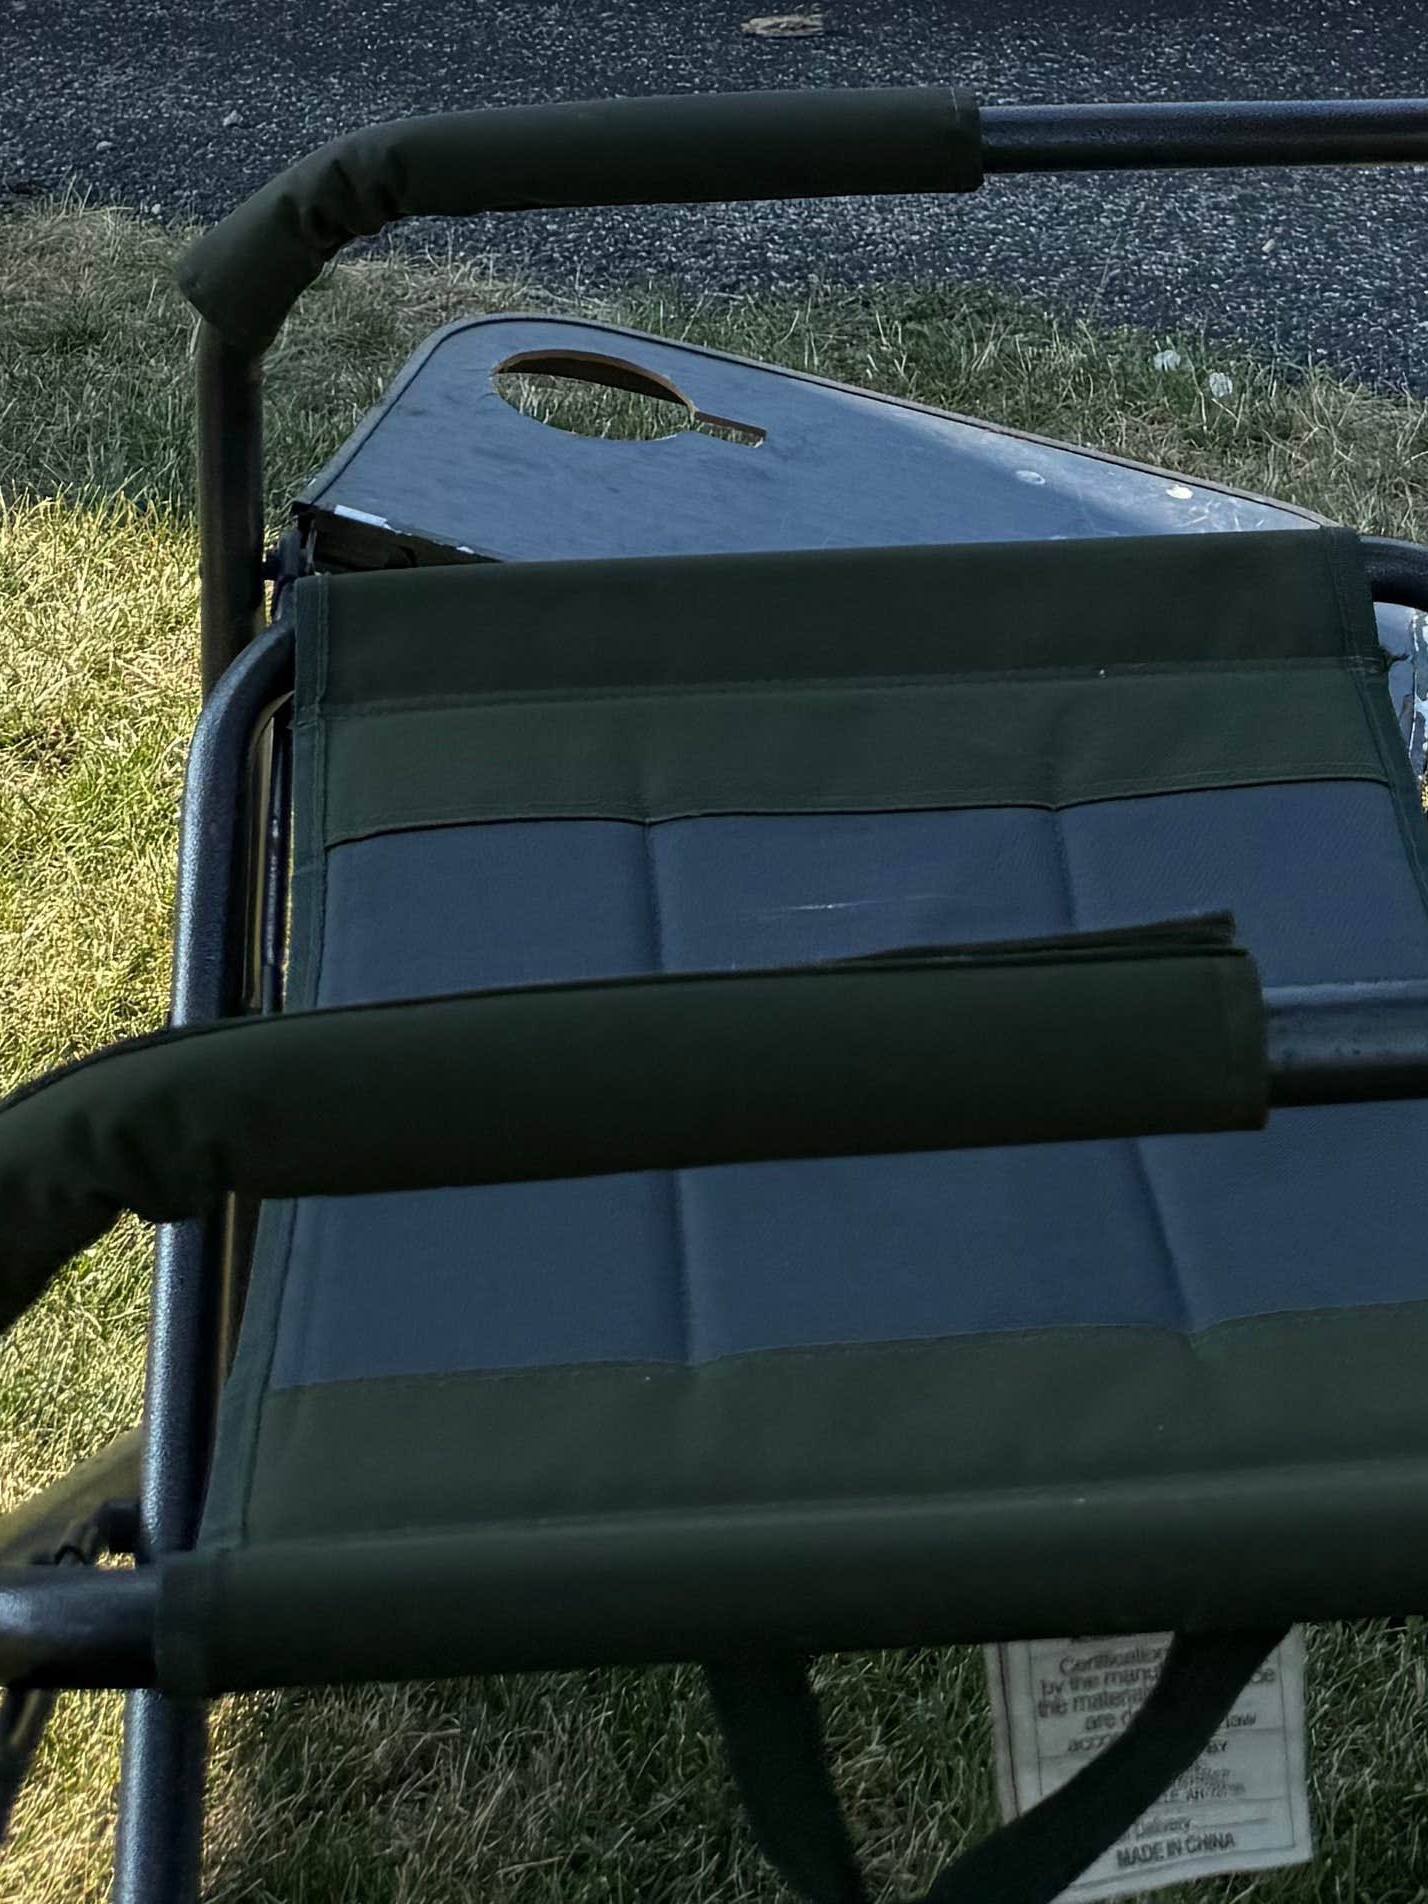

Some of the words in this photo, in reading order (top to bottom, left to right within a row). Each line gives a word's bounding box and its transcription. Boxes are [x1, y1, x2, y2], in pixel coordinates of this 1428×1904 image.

[1116, 1841, 1165, 1869] MADE
[1167, 1838, 1183, 1858] IN
[1185, 1831, 1237, 1854] CHINA
